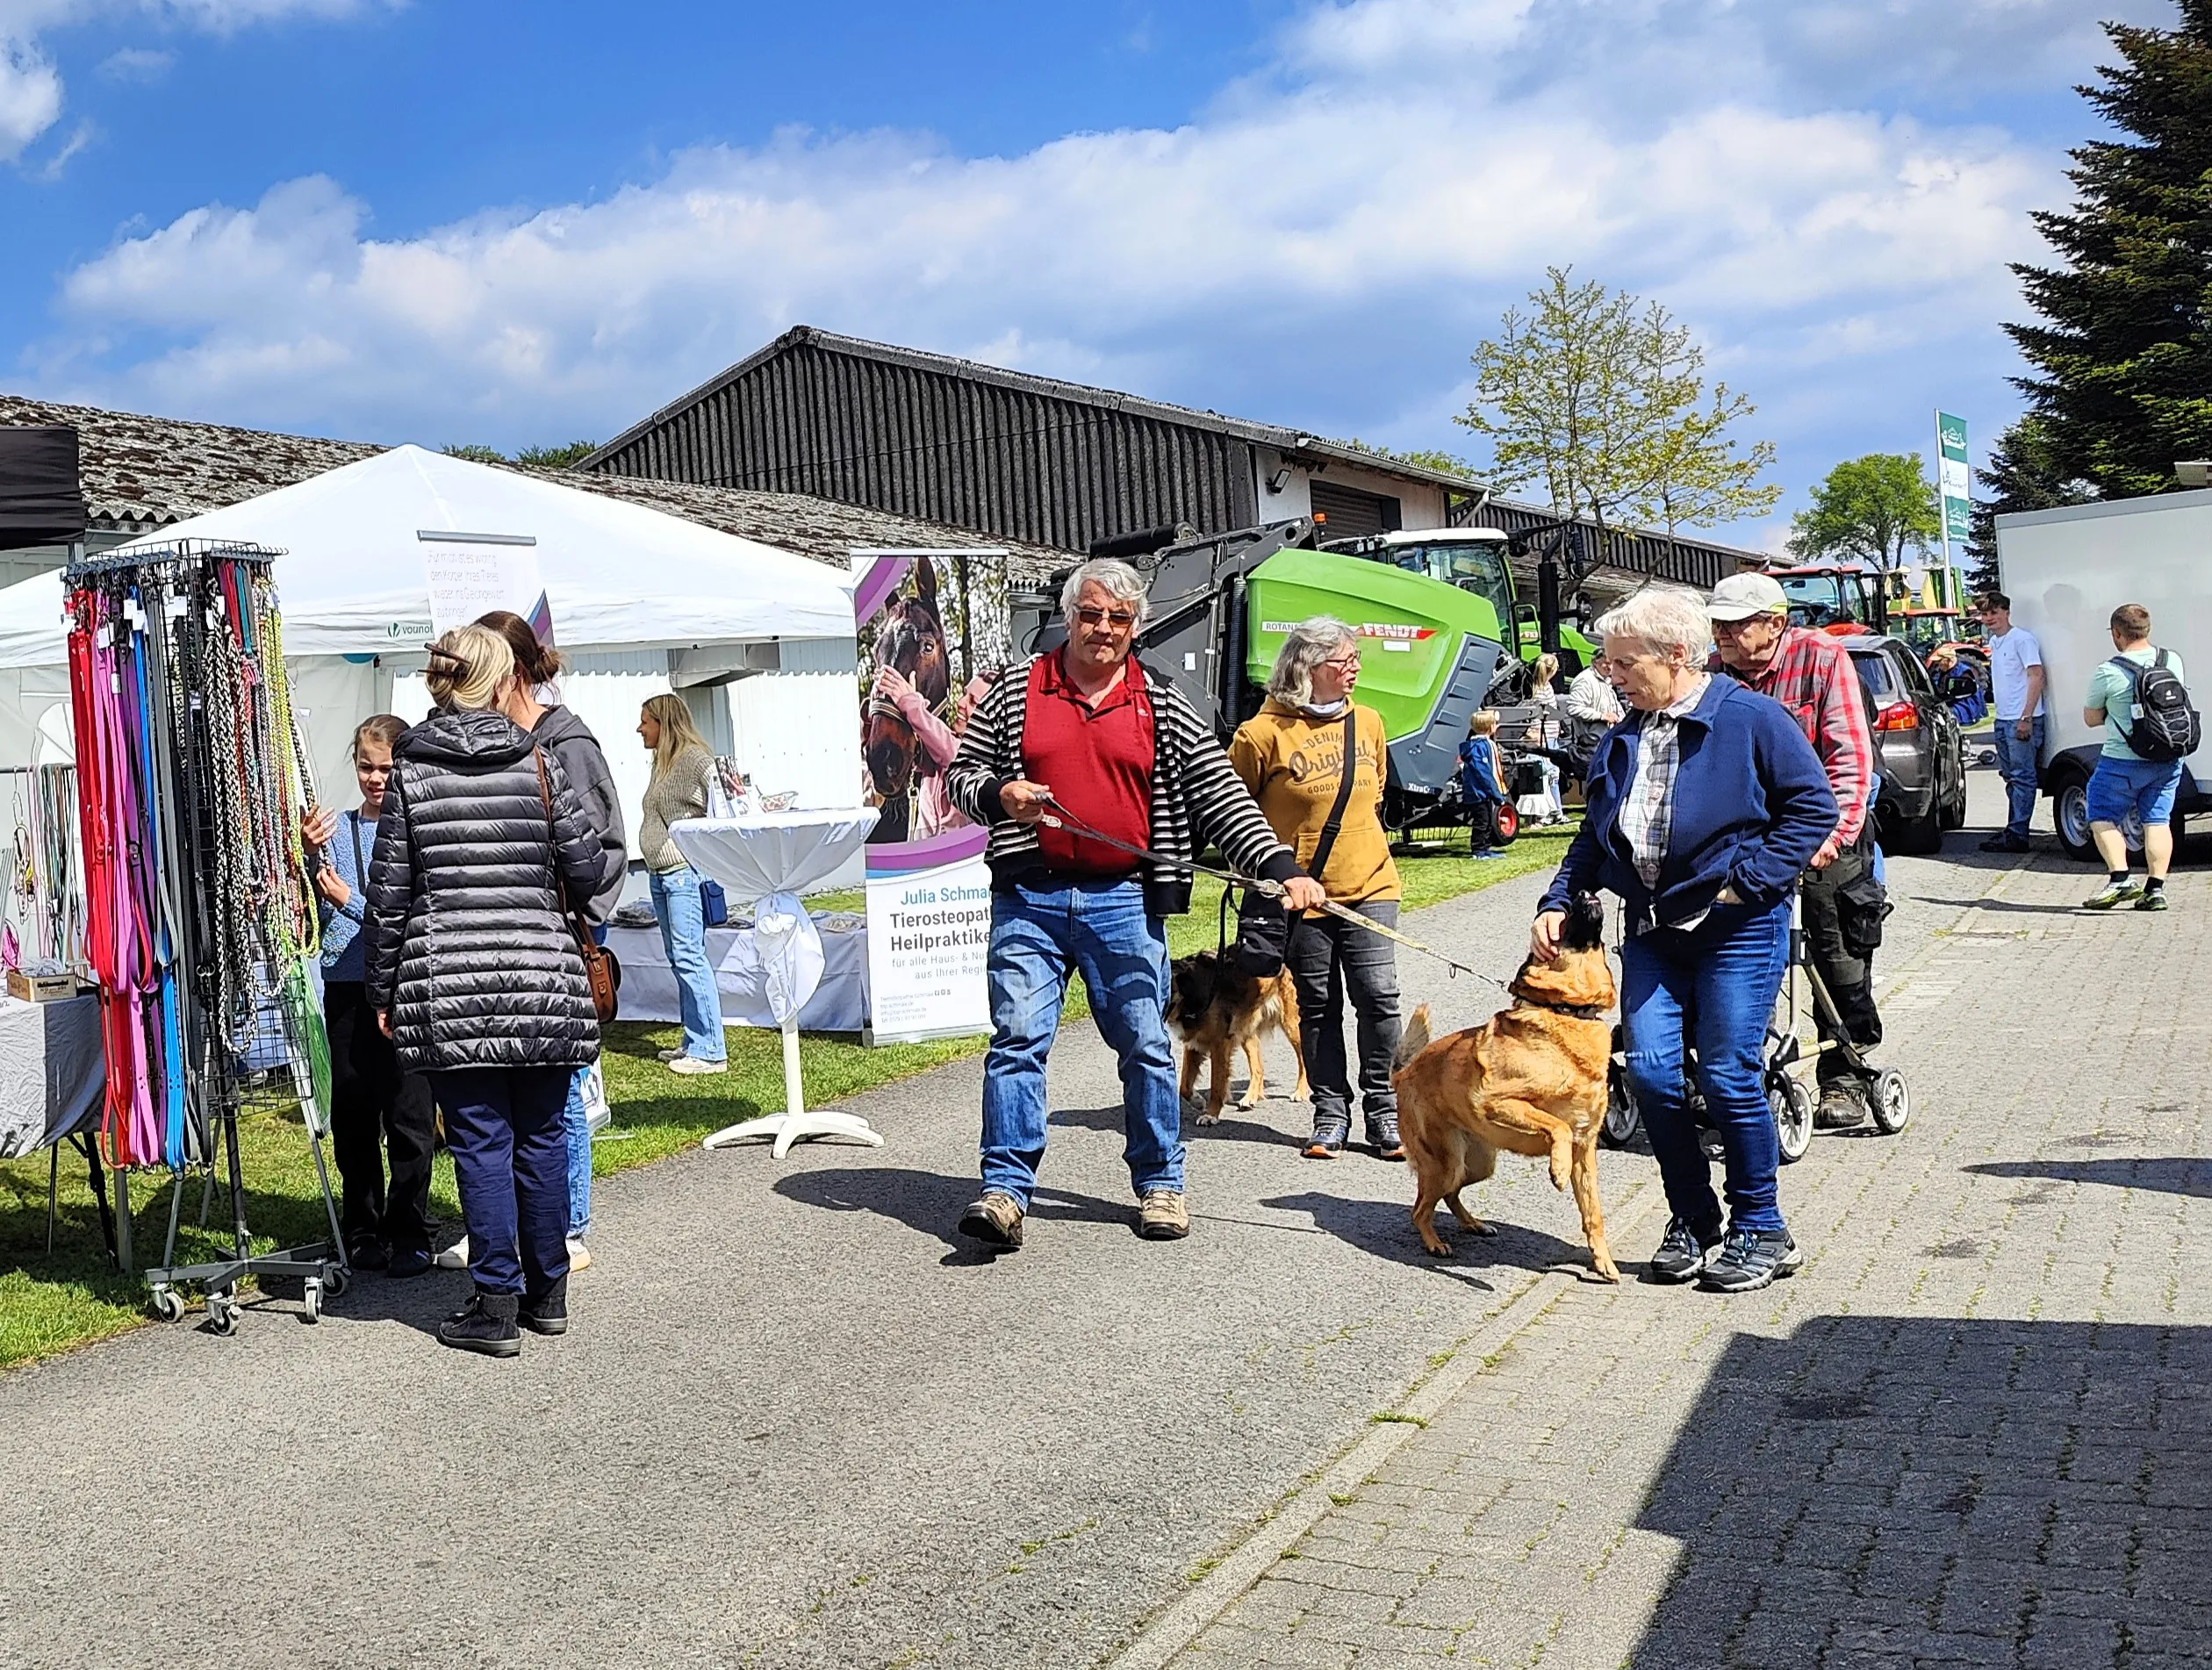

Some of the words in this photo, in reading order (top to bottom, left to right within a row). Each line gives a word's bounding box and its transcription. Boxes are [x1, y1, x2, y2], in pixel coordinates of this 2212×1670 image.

[1362, 622, 1422, 639] FENDT
[1307, 731, 1343, 747] DENIM
[1289, 739, 1371, 783] Origial
[1307, 782, 1335, 794] GOODS
[901, 889, 936, 906] Julia
[890, 907, 990, 928] Tierosteopat
[891, 928, 990, 952] Heilpraktike
[892, 957, 905, 968] für
[909, 956, 927, 966] alle
[930, 954, 958, 964] Haus-
[962, 952, 968, 961] &
[972, 951, 987, 961] Nu
[915, 971, 932, 979] aus
[936, 968, 959, 978] Ihrer
